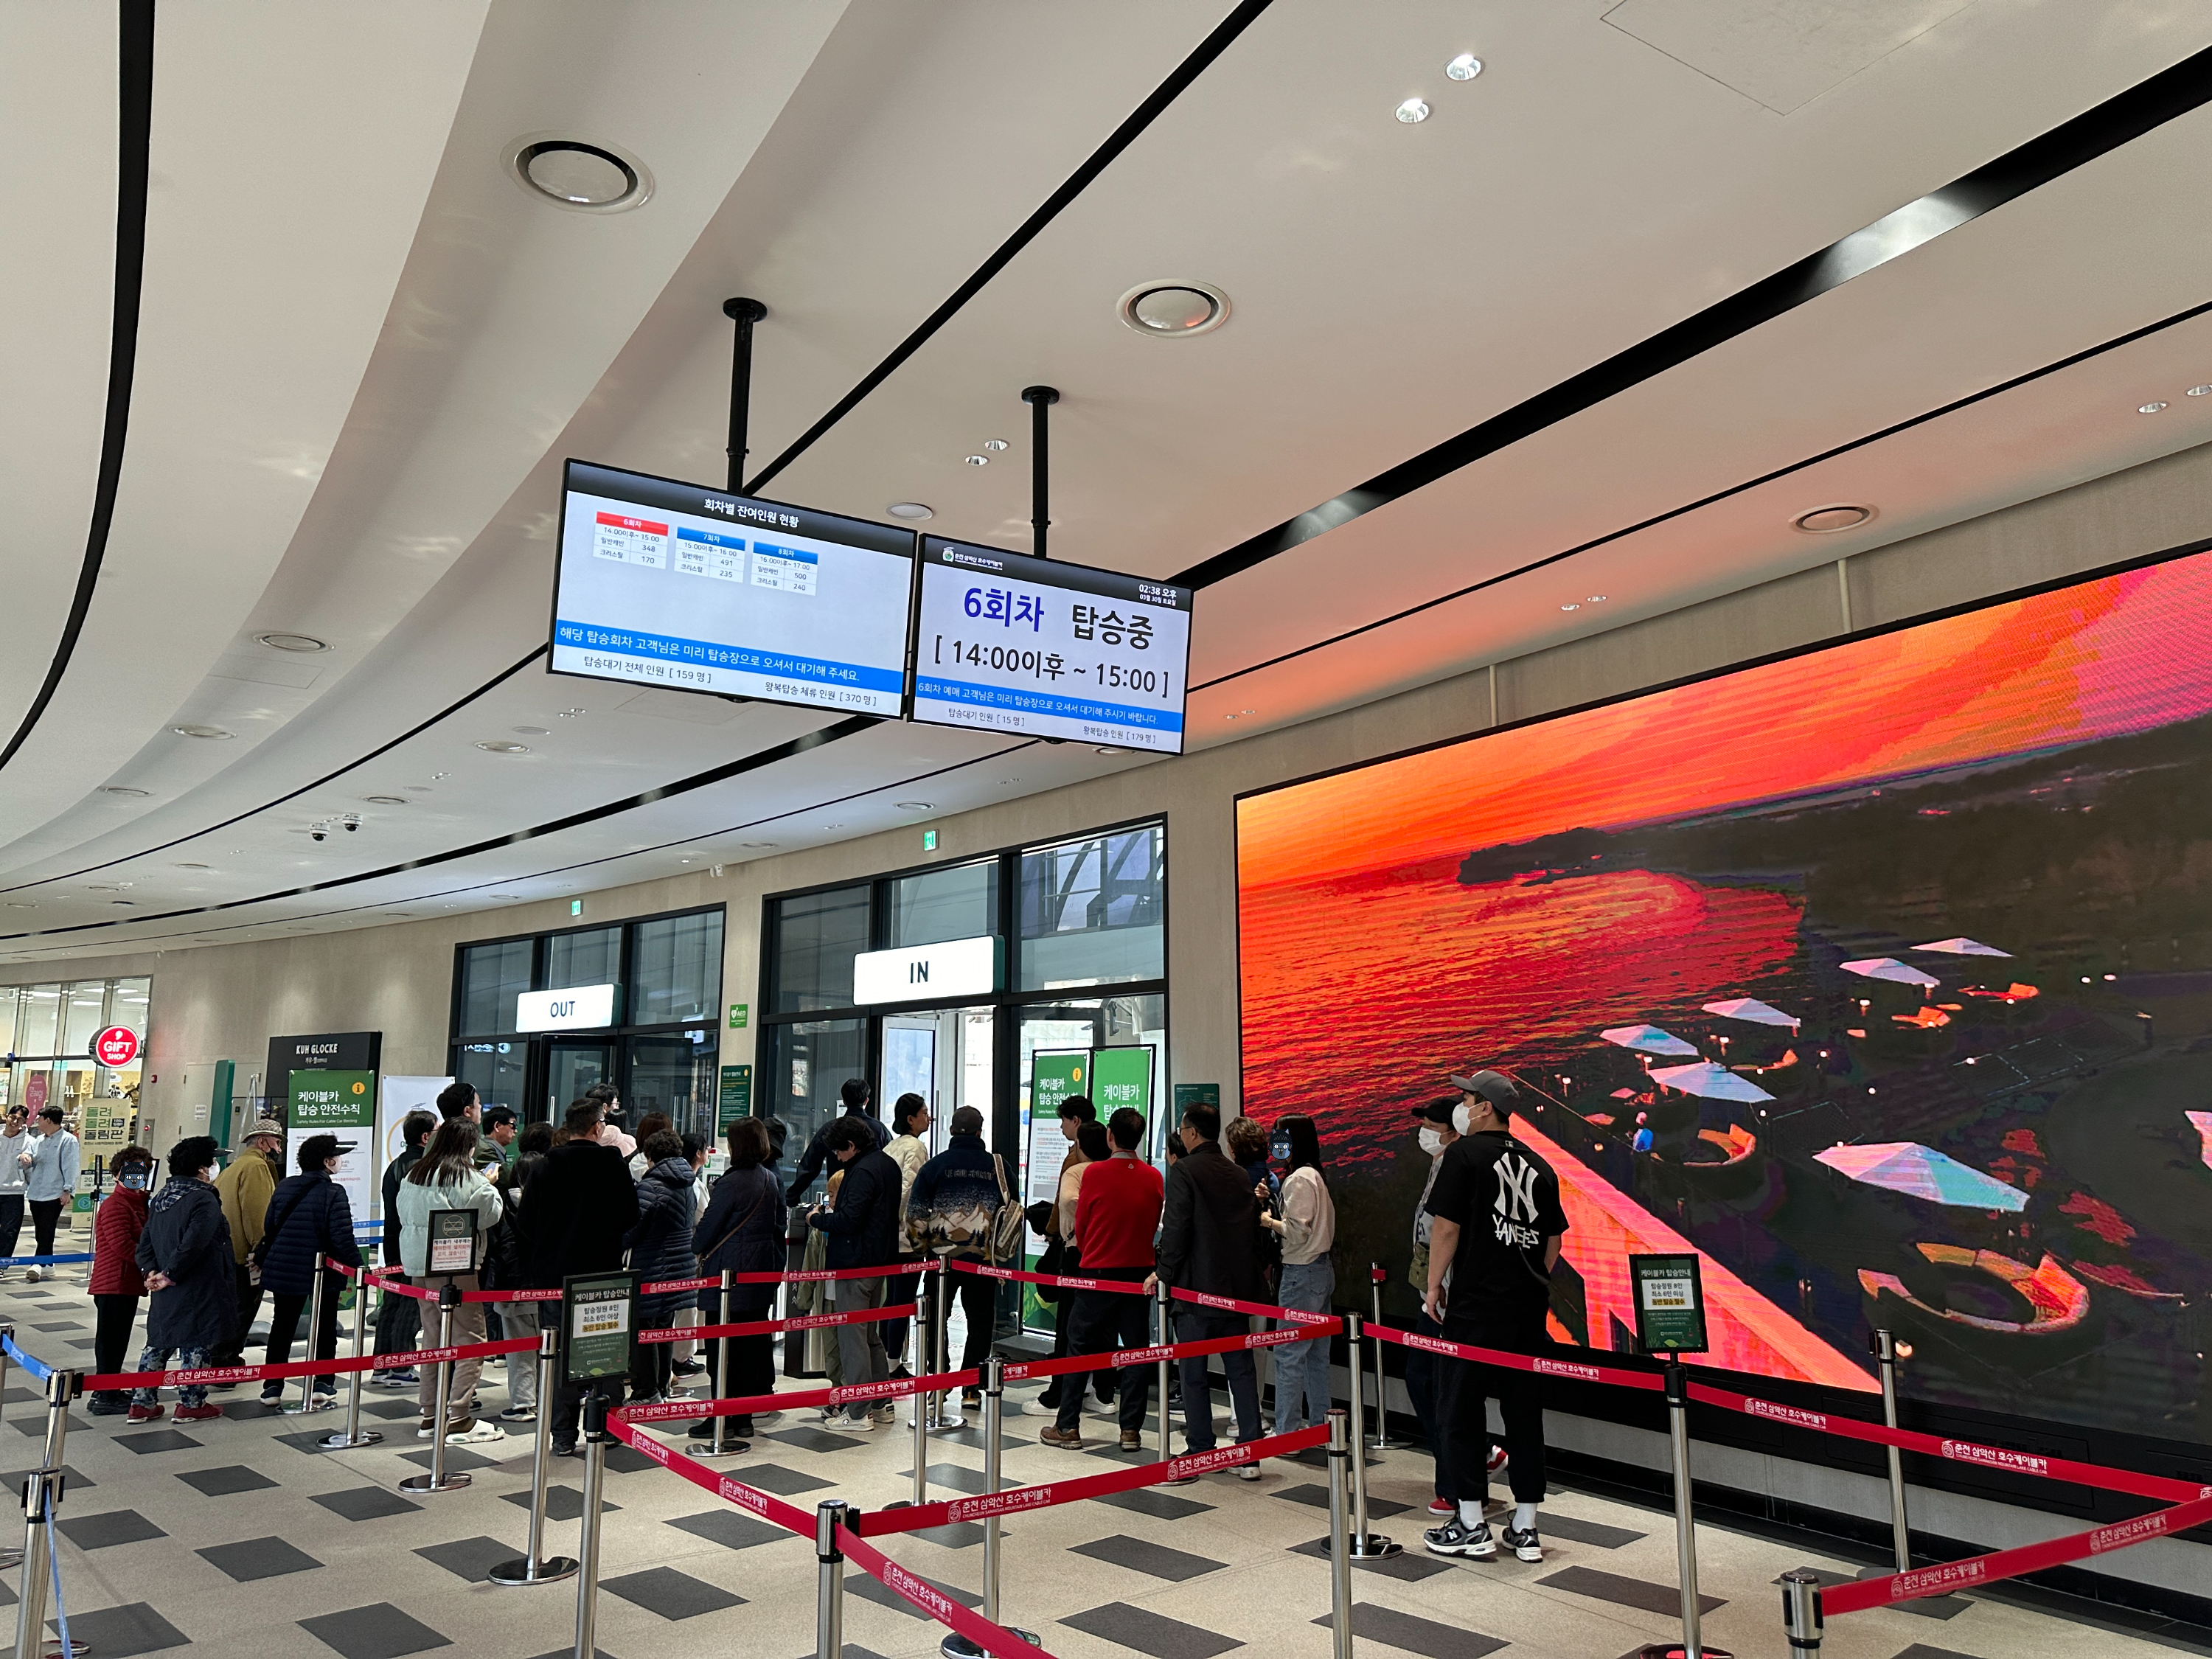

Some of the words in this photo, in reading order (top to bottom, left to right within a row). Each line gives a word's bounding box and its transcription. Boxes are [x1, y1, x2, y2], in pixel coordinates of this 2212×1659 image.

[704, 498, 735, 515] 회차별
[737, 504, 777, 523] 잔여인원
[779, 513, 799, 528] 현황
[624, 518, 641, 529] 6회차
[703, 533, 720, 544] 7회차
[641, 543, 656, 552] 348
[778, 548, 795, 558] 8회차
[641, 555, 655, 564] 170
[720, 558, 734, 567] 491
[719, 569, 733, 578] 235
[794, 571, 807, 580] 500
[793, 582, 806, 591] 240
[1139, 584, 1161, 595] 02:38
[1162, 588, 1177, 599] 오후
[964, 588, 1045, 632] 6회차
[1072, 605, 1154, 650] 탑승중
[560, 627, 583, 641] 해당
[587, 630, 633, 648] 탑승회차
[635, 639, 681, 655] 고객님은
[684, 645, 705, 659] 미리
[708, 649, 759, 667] 탑승장으로
[762, 658, 793, 672] 오셔서
[796, 662, 826, 677] 대기해
[828, 668, 860, 682] 주세요.
[584, 655, 622, 671] 탑승대기
[625, 661, 644, 673] 전체
[646, 665, 664, 677] 인원
[676, 669, 694, 680] 159
[696, 672, 706, 683] 명
[953, 639, 1065, 681] 14:00이후
[1096, 664, 1155, 693] 15:00
[765, 681, 799, 695] 왕복탑승
[801, 686, 818, 698] 체류
[820, 689, 835, 700] 인원
[845, 693, 861, 703] 370
[863, 695, 872, 706] 명
[919, 682, 942, 695] 6회차
[943, 686, 960, 697] 예매
[961, 688, 995, 702] 고객님은
[997, 693, 1013, 704] 미리
[1015, 695, 1054, 709] 탑승장으로
[1055, 701, 1079, 714] 오셔서
[1080, 705, 1102, 717] 대기해
[1104, 709, 1126, 720] 주시기
[1128, 712, 1158, 725] 바랍니다.
[948, 708, 977, 720] 탑승대기
[979, 712, 993, 722] 인원
[1003, 716, 1012, 724] 15
[1013, 717, 1020, 726] 명
[1083, 726, 1109, 737] 왕복탑승
[1111, 729, 1124, 740] 인원
[1132, 732, 1144, 741] 179
[1145, 734, 1152, 743] 명
[911, 961, 929, 984] IN
[550, 1001, 576, 1018] OUT
[103, 1041, 132, 1052] GIFT
[296, 1044, 310, 1054] KUH
[311, 1043, 338, 1054] GLOCKE
[1039, 1078, 1065, 1090] 케이블카
[298, 1091, 339, 1102] 케이블카
[1103, 1084, 1140, 1101] 케이블카
[1039, 1093, 1052, 1105] 탑승
[86, 1107, 111, 1117] 돌려
[297, 1104, 319, 1116] 탑승
[320, 1103, 360, 1115] 안전수칙
[85, 1119, 111, 1128] 돌려
[84, 1130, 124, 1140] 돌림판
[1666, 1268, 1691, 1277] 탑승안내
[575, 1291, 602, 1301] 케이블카
[603, 1288, 630, 1299] 탑승안내
[584, 1305, 608, 1315] 탑승정원
[177, 1371, 192, 1380] 춘천
[841, 1388, 854, 1397] 춘천
[629, 1408, 644, 1417] 춘천
[646, 1406, 668, 1416] 삼악산
[1955, 1443, 1970, 1455] 춘천
[1972, 1447, 1995, 1460] 삼악산
[1997, 1451, 2047, 1470] 호수케이블카
[1179, 1458, 1192, 1471] 춘천
[962, 1500, 978, 1513] 춘천
[981, 1495, 1004, 1510] 삼악산
[1006, 1487, 1051, 1504] 호수케이블카
[1448, 1530, 1458, 1540] N
[892, 1568, 903, 1585] 춘천
[1904, 1574, 1919, 1590] 춘천
